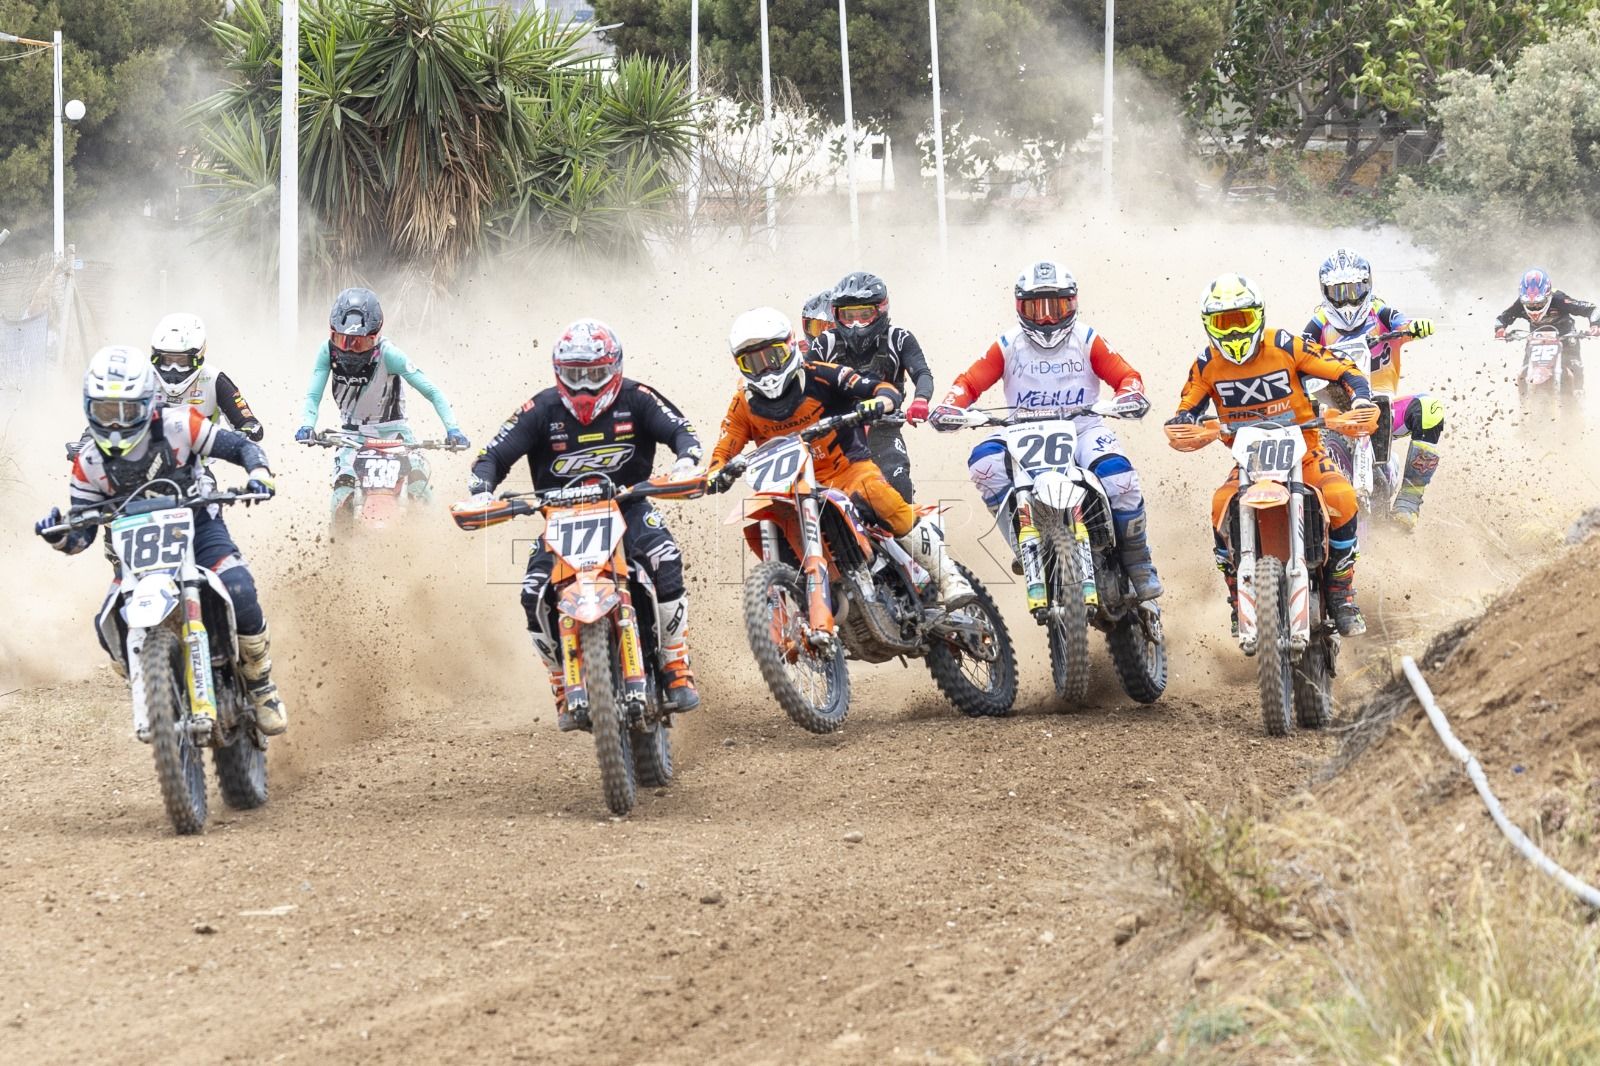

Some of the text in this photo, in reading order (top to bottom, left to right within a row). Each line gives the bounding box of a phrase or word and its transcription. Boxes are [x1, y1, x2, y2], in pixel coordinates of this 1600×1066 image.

[1215, 371, 1291, 406] FXR
[1017, 433, 1074, 467] 26
[1247, 440, 1295, 472] 100
[751, 449, 800, 491] 70
[121, 522, 190, 569] 185
[560, 517, 613, 556] 171
